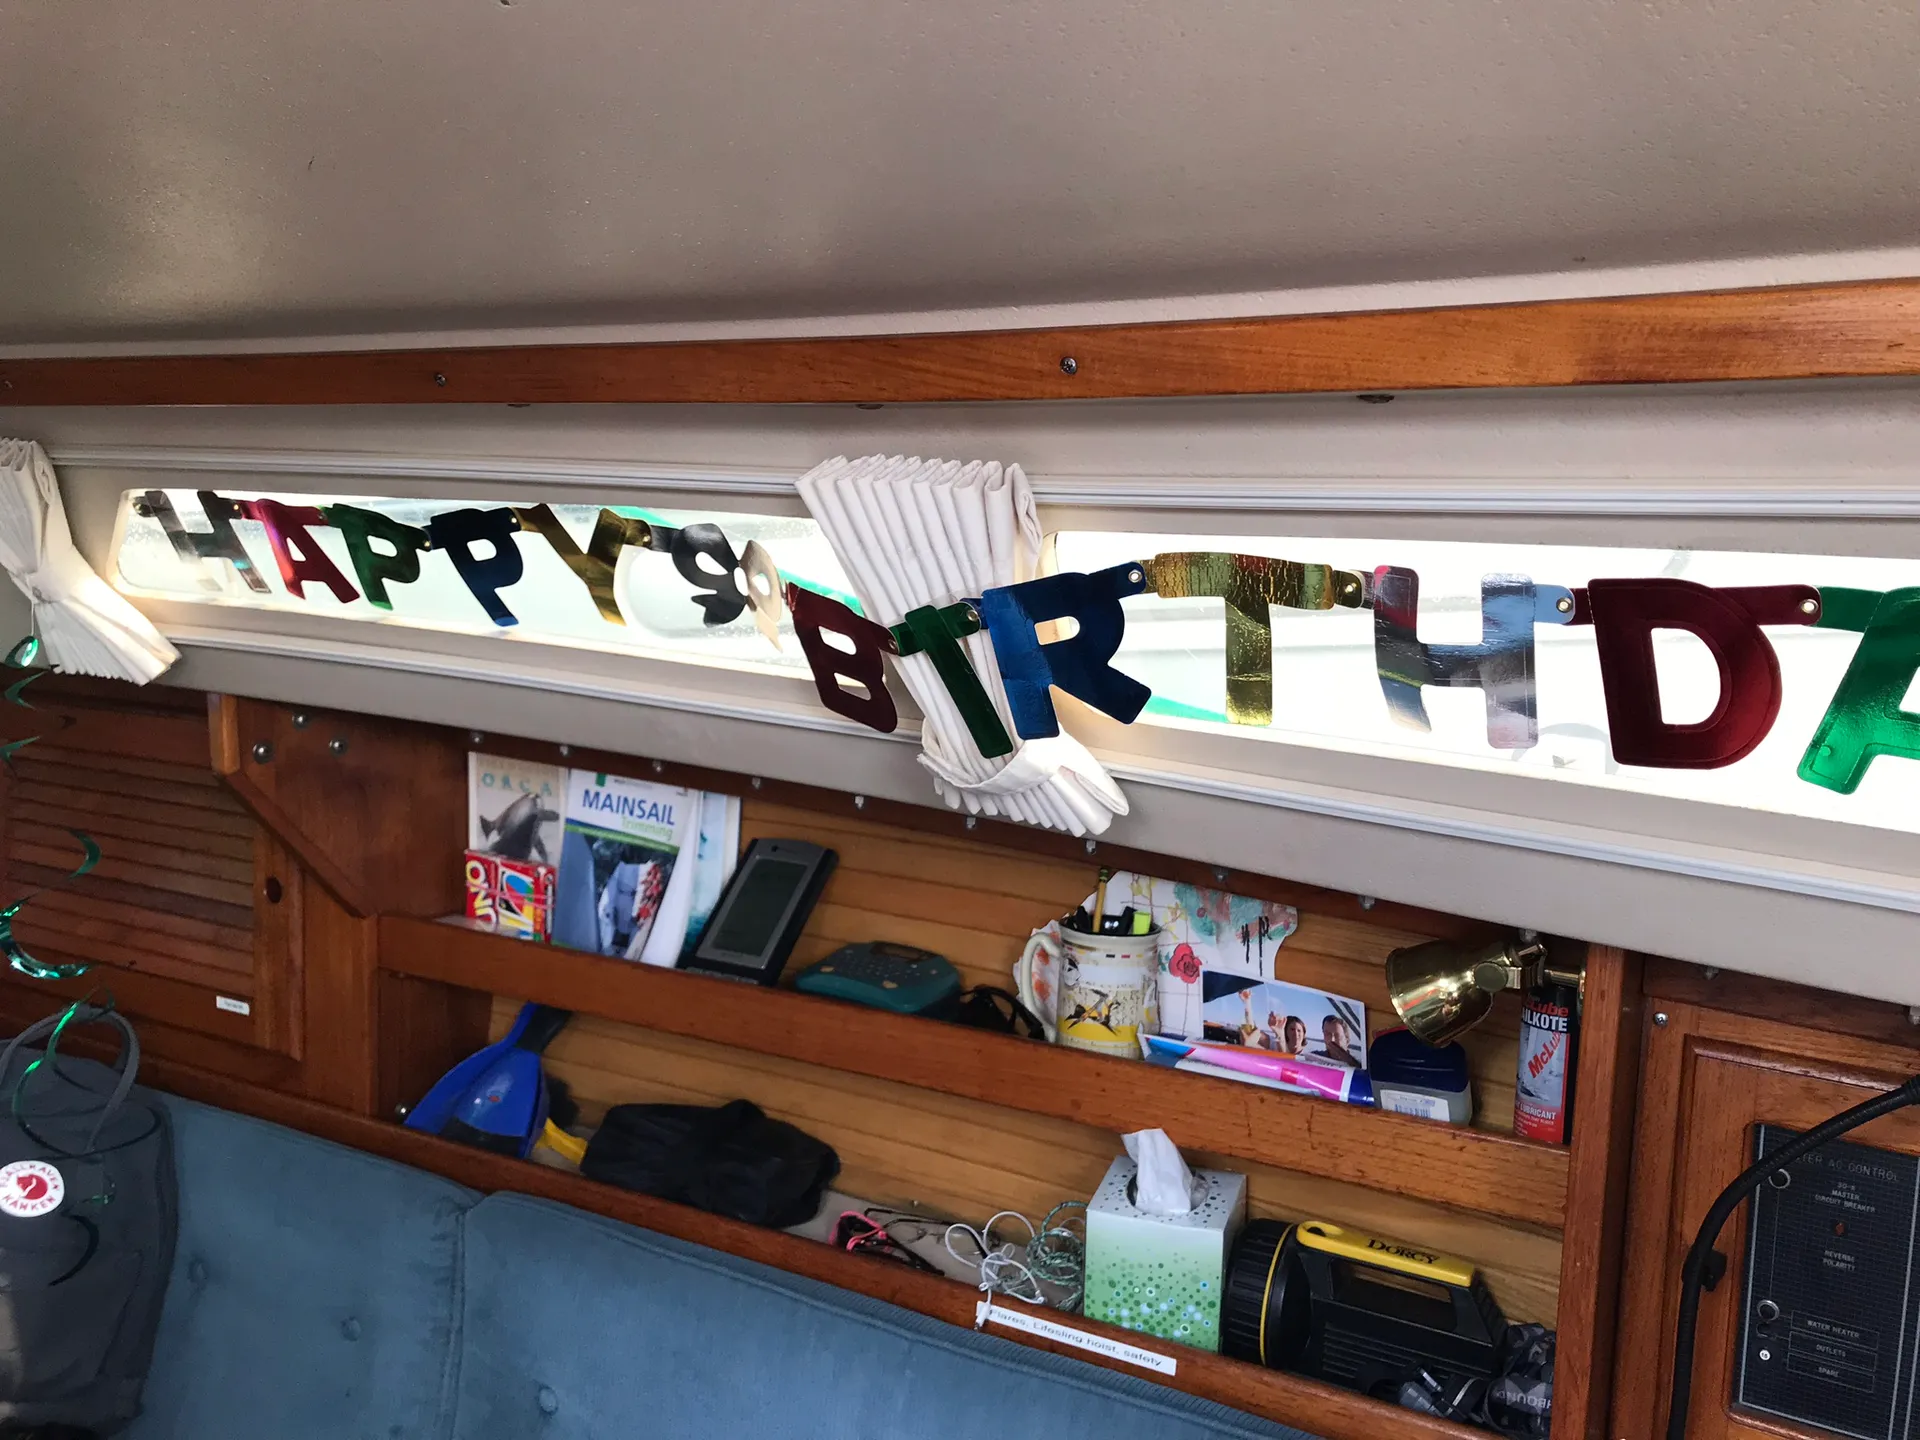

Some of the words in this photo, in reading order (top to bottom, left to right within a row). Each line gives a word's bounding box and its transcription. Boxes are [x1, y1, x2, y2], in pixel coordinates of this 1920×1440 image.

[133, 490, 652, 628] HAPPY
[481, 772, 552, 796] ORCA
[582, 788, 675, 826] MAINSAIL
[465, 860, 497, 932] UNO
[1848, 1162, 1897, 1181] CONTROL
[1831, 1189, 1860, 1201] MASTER
[1807, 1320, 1830, 1331] WATER
[1832, 1326, 1860, 1338] HEATER
[1816, 1344, 1846, 1358] OUTLETS
[1818, 1366, 1839, 1378] SPARE
